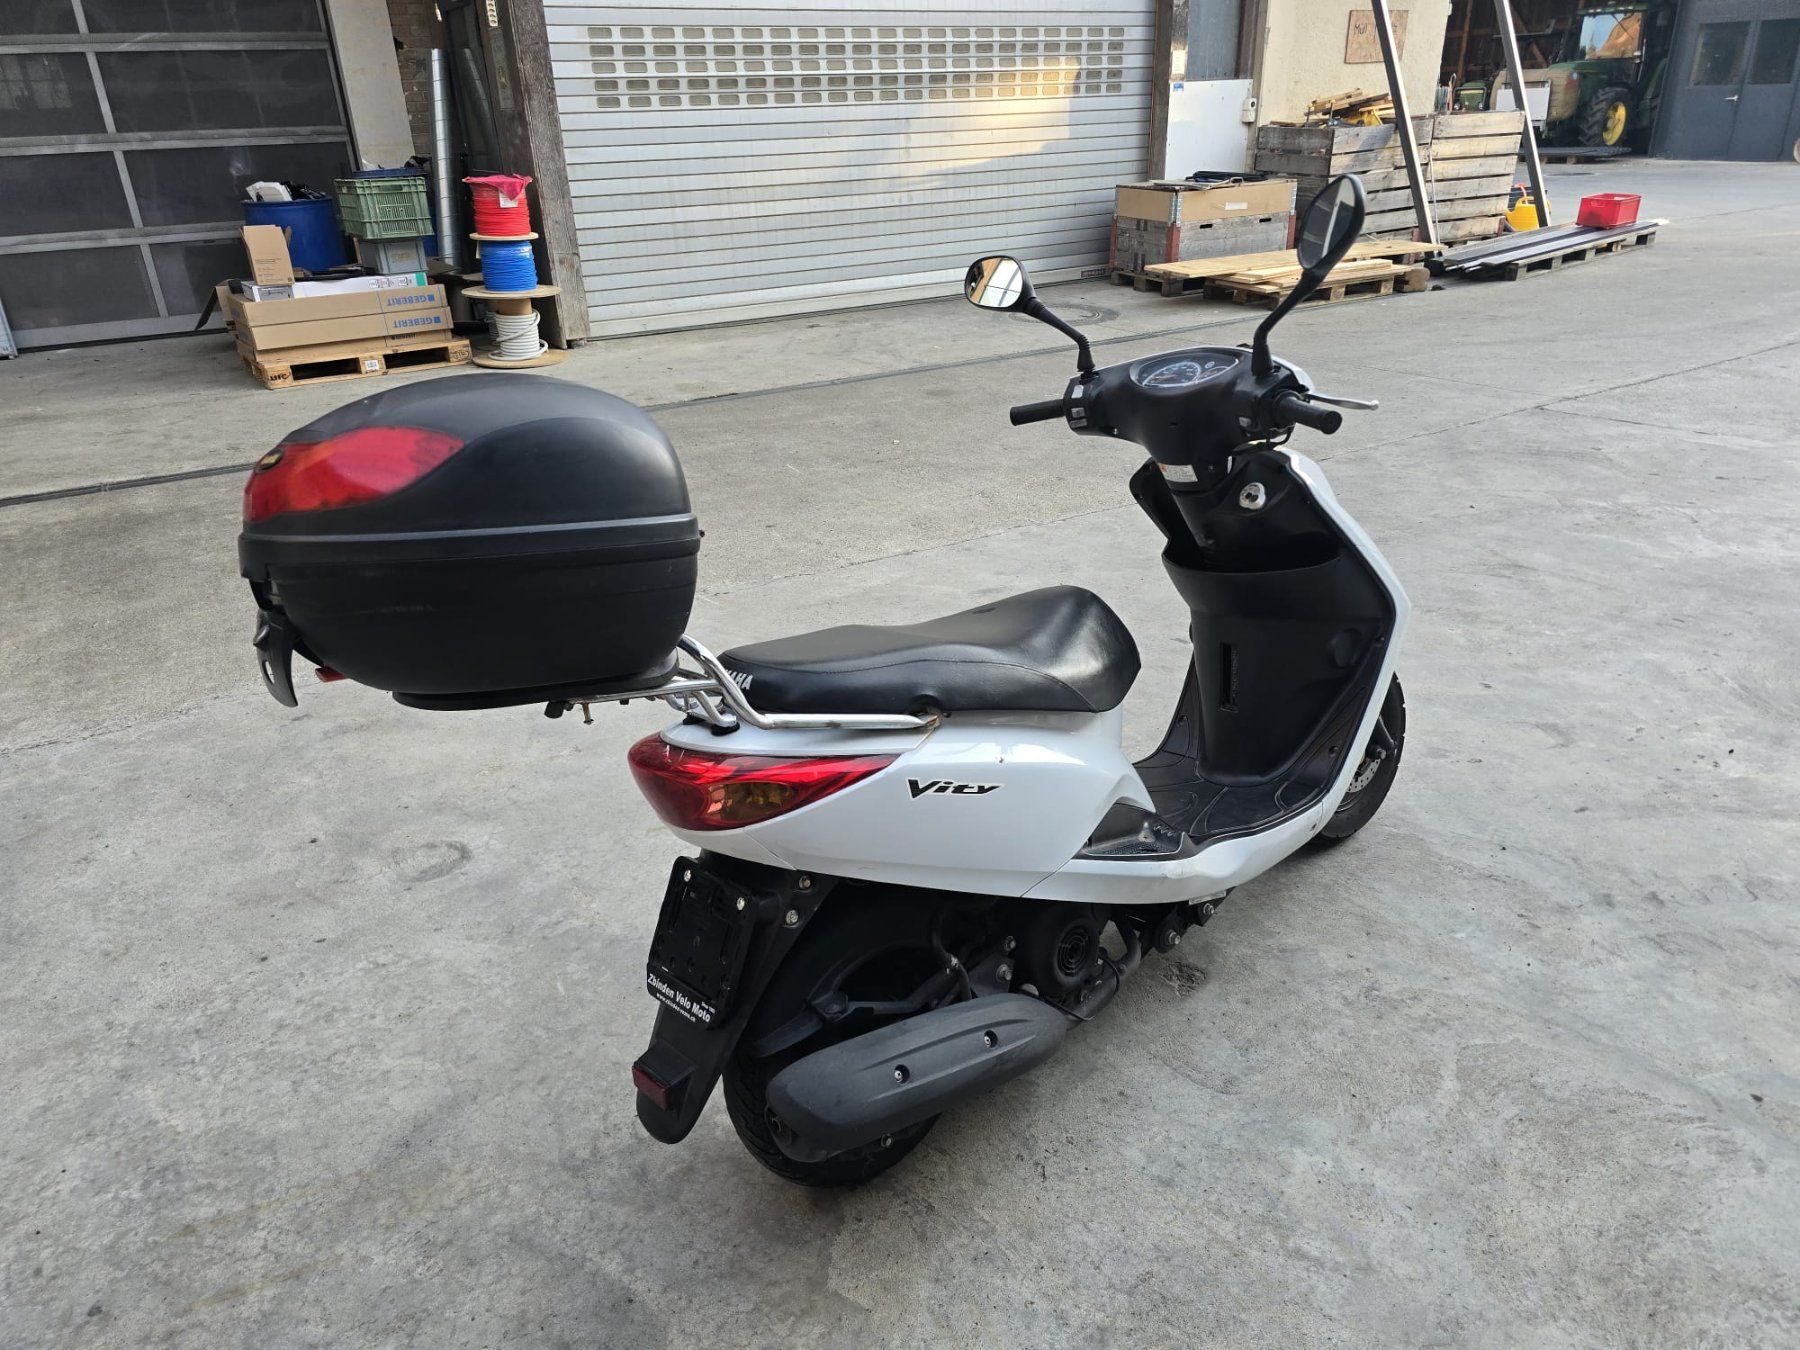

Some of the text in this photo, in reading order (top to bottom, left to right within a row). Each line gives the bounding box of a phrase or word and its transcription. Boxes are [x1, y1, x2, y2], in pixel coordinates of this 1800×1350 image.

[387, 295, 427, 306] GEBERIT
[393, 317, 433, 328] GEBERIT
[907, 779, 1001, 799] Vity
[648, 973, 711, 1022] Zbinden Velo Moto
